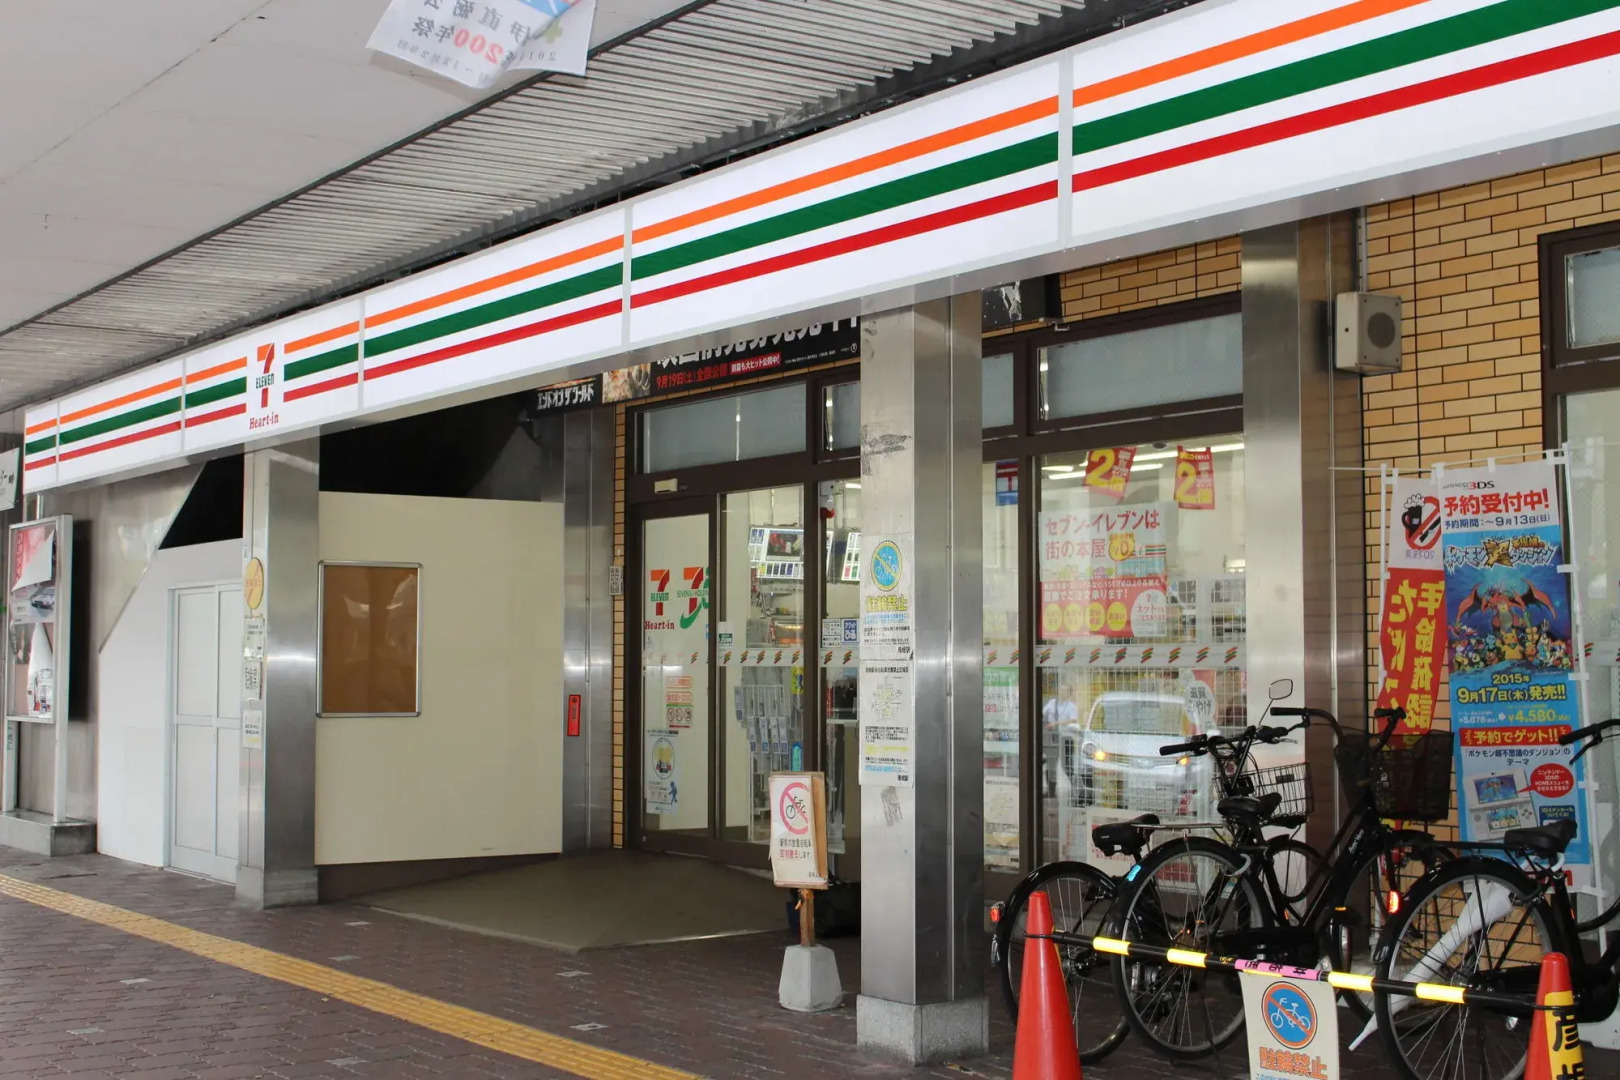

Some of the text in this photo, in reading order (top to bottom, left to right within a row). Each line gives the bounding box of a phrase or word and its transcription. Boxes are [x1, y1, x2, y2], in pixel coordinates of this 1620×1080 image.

[256, 373, 275, 389] ELEVEN
[1467, 480, 1495, 490] 3DS
[1444, 488, 1549, 517] 予約受付中!
[1046, 538, 1106, 561] 街の本屋
[650, 592, 670, 602] ELEVEN
[1492, 673, 1531, 684] 2015年
[1473, 729, 1558, 745] 予約でゲット!!
[1258, 1046, 1329, 1080] 駐輪禁止
